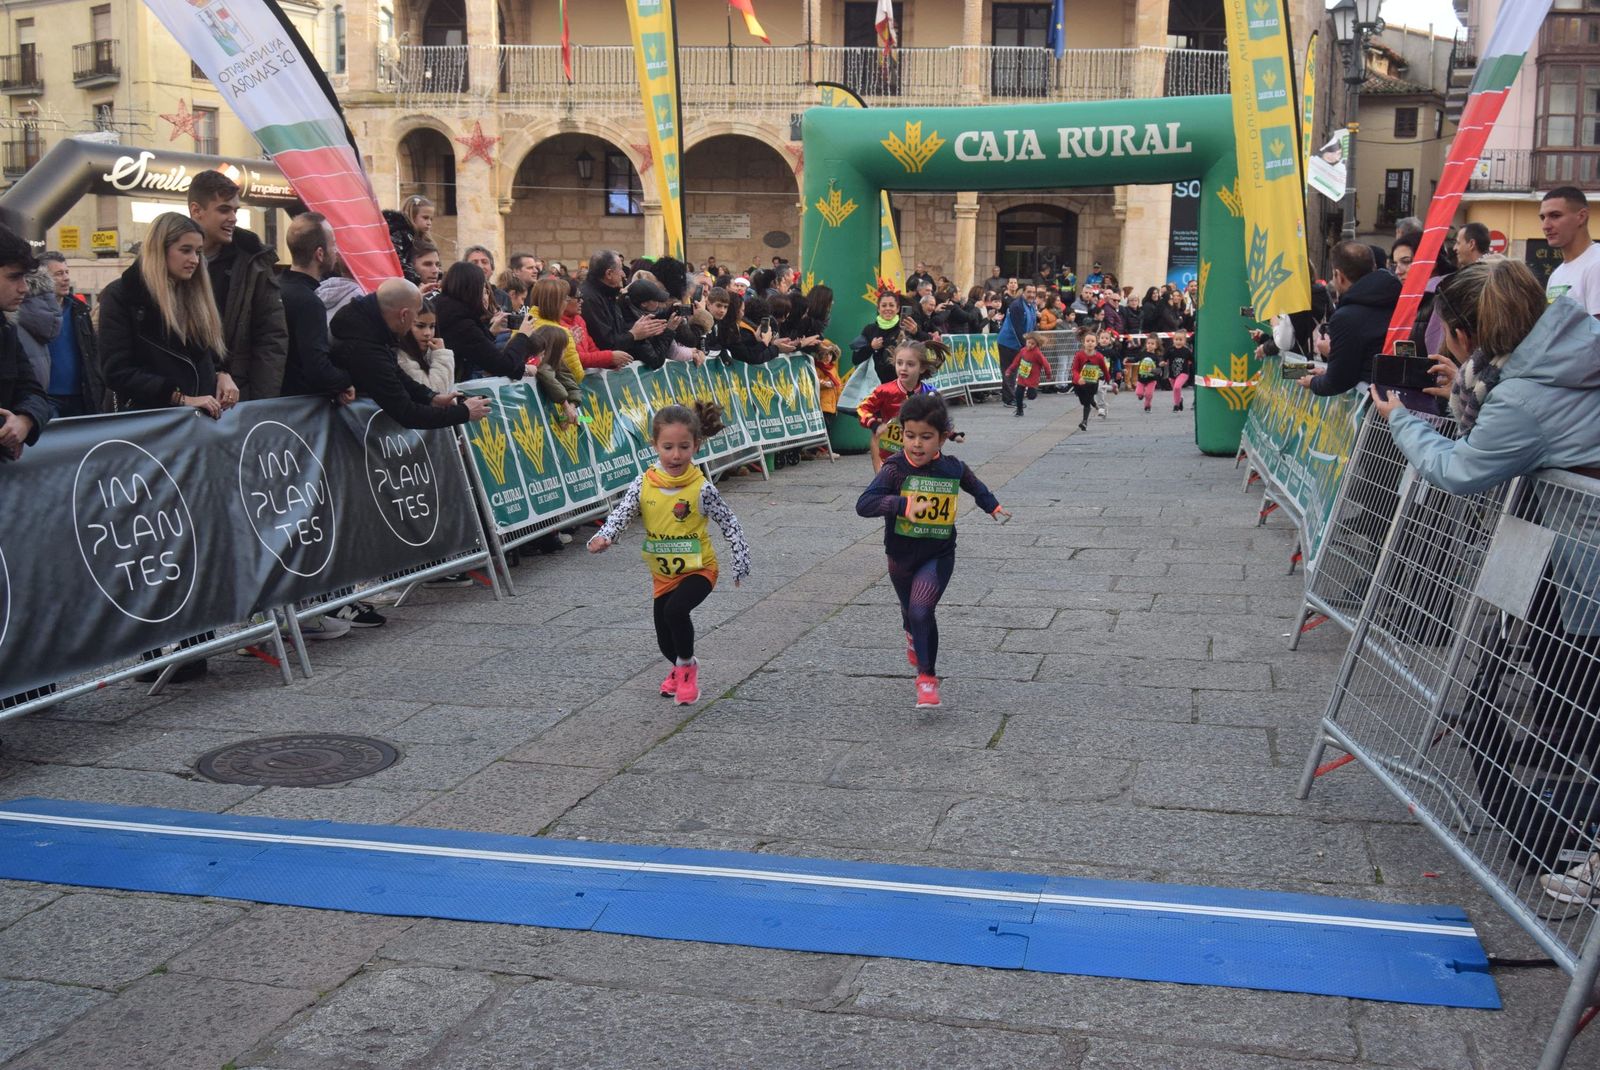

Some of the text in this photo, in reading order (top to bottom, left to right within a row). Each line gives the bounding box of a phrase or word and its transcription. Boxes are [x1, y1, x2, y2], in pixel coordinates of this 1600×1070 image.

[954, 122, 1193, 163] CAJA RURAL
[379, 434, 412, 459] IM
[887, 424, 903, 443] 13
[258, 450, 300, 479] IM
[375, 461, 430, 493] PLAN
[98, 473, 153, 508] IM
[251, 479, 325, 519] PLAN
[392, 493, 430, 521] TES
[87, 508, 183, 555] PLAN
[275, 516, 323, 548] TES
[115, 551, 181, 591] TES
[656, 556, 686, 576] 32
